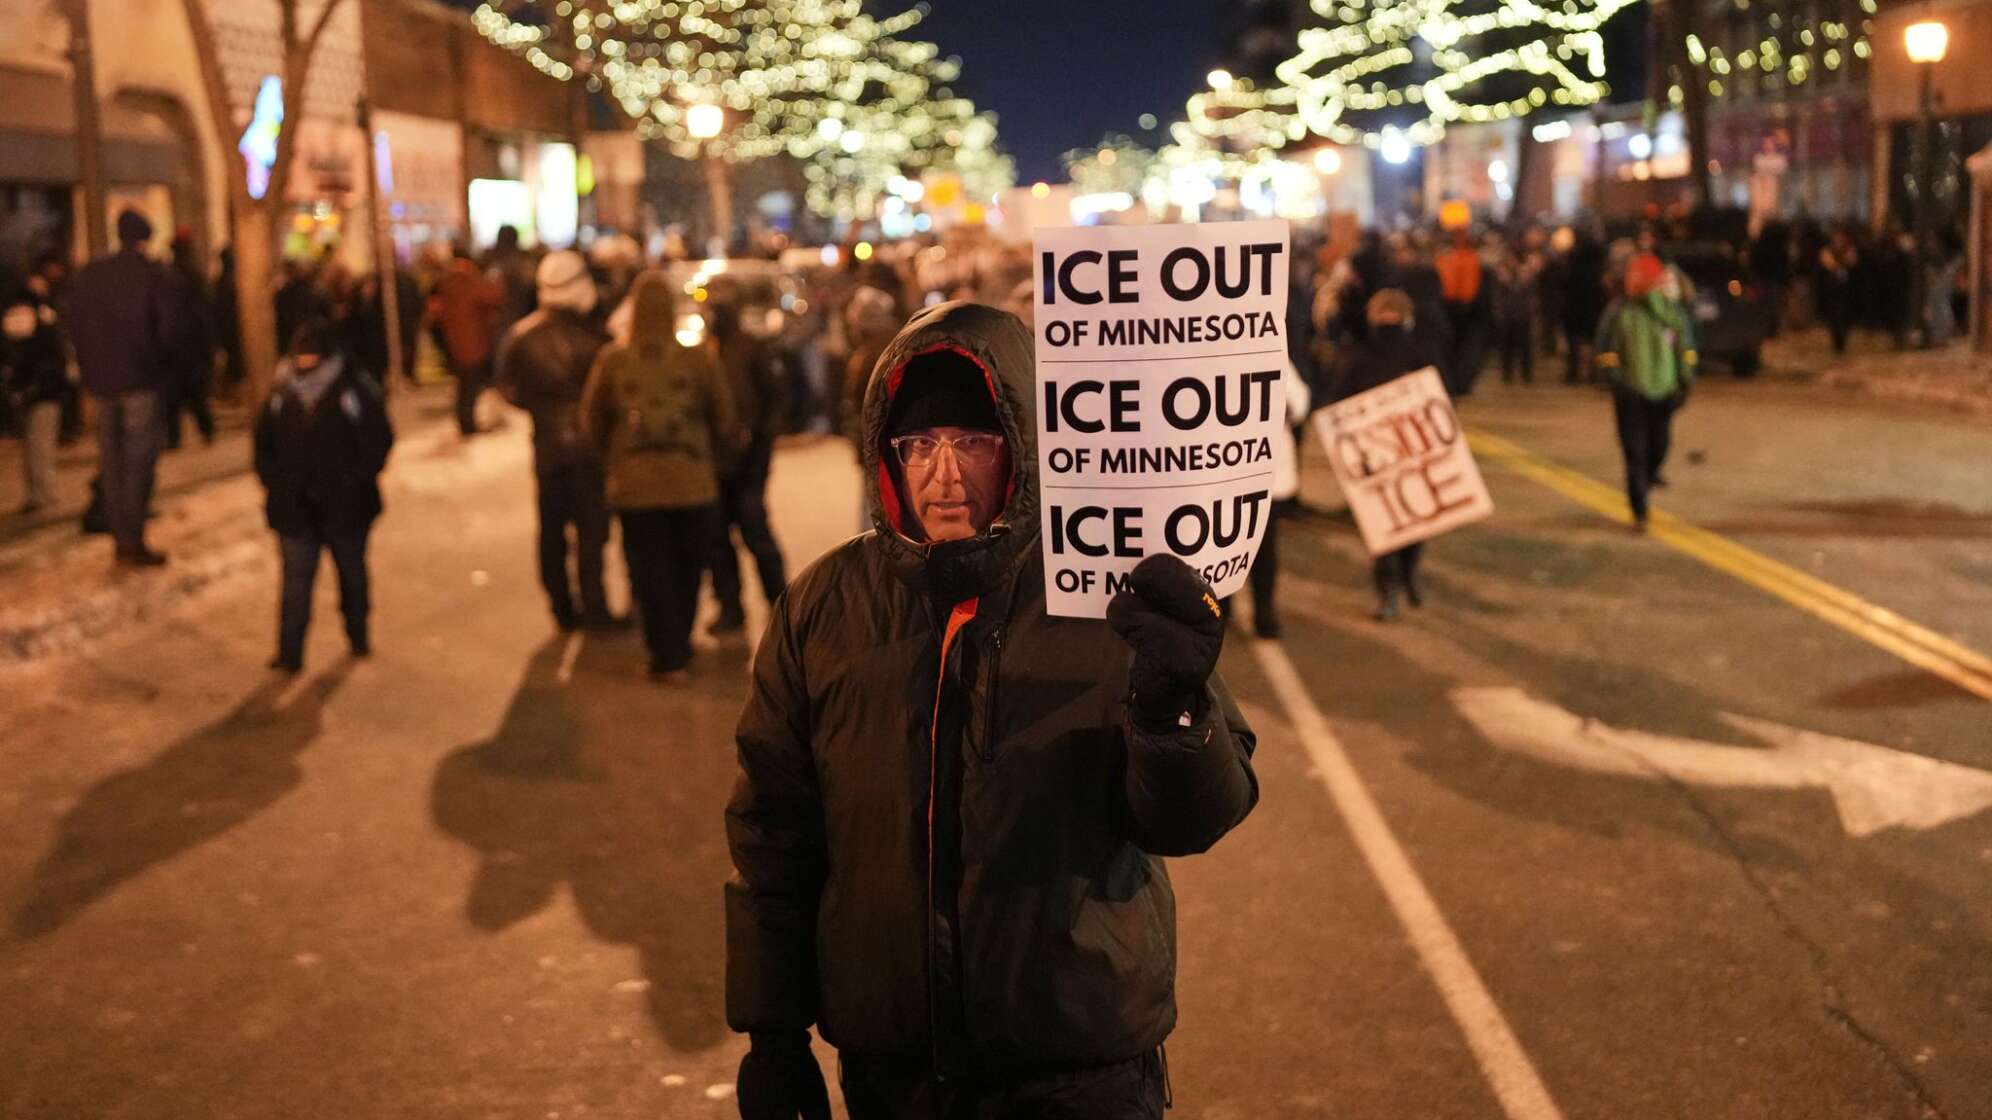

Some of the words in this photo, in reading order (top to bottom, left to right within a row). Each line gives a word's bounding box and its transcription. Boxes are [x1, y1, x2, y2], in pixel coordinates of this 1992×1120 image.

[1042, 249, 1140, 306] ICE
[1159, 242, 1283, 302] OUT
[1044, 320, 1089, 348] OF
[1098, 311, 1279, 346] MINNESOTA
[1044, 379, 1141, 434] ICE
[1161, 369, 1282, 431] OUT
[1048, 447, 1091, 474] OF
[1099, 436, 1272, 474] MINNESOTA
[1049, 505, 1145, 558] ICE
[1163, 489, 1269, 557] OUT
[1361, 450, 1476, 535] ICE
[1055, 568, 1095, 594] OF
[1105, 552, 1250, 595] MSOTA
